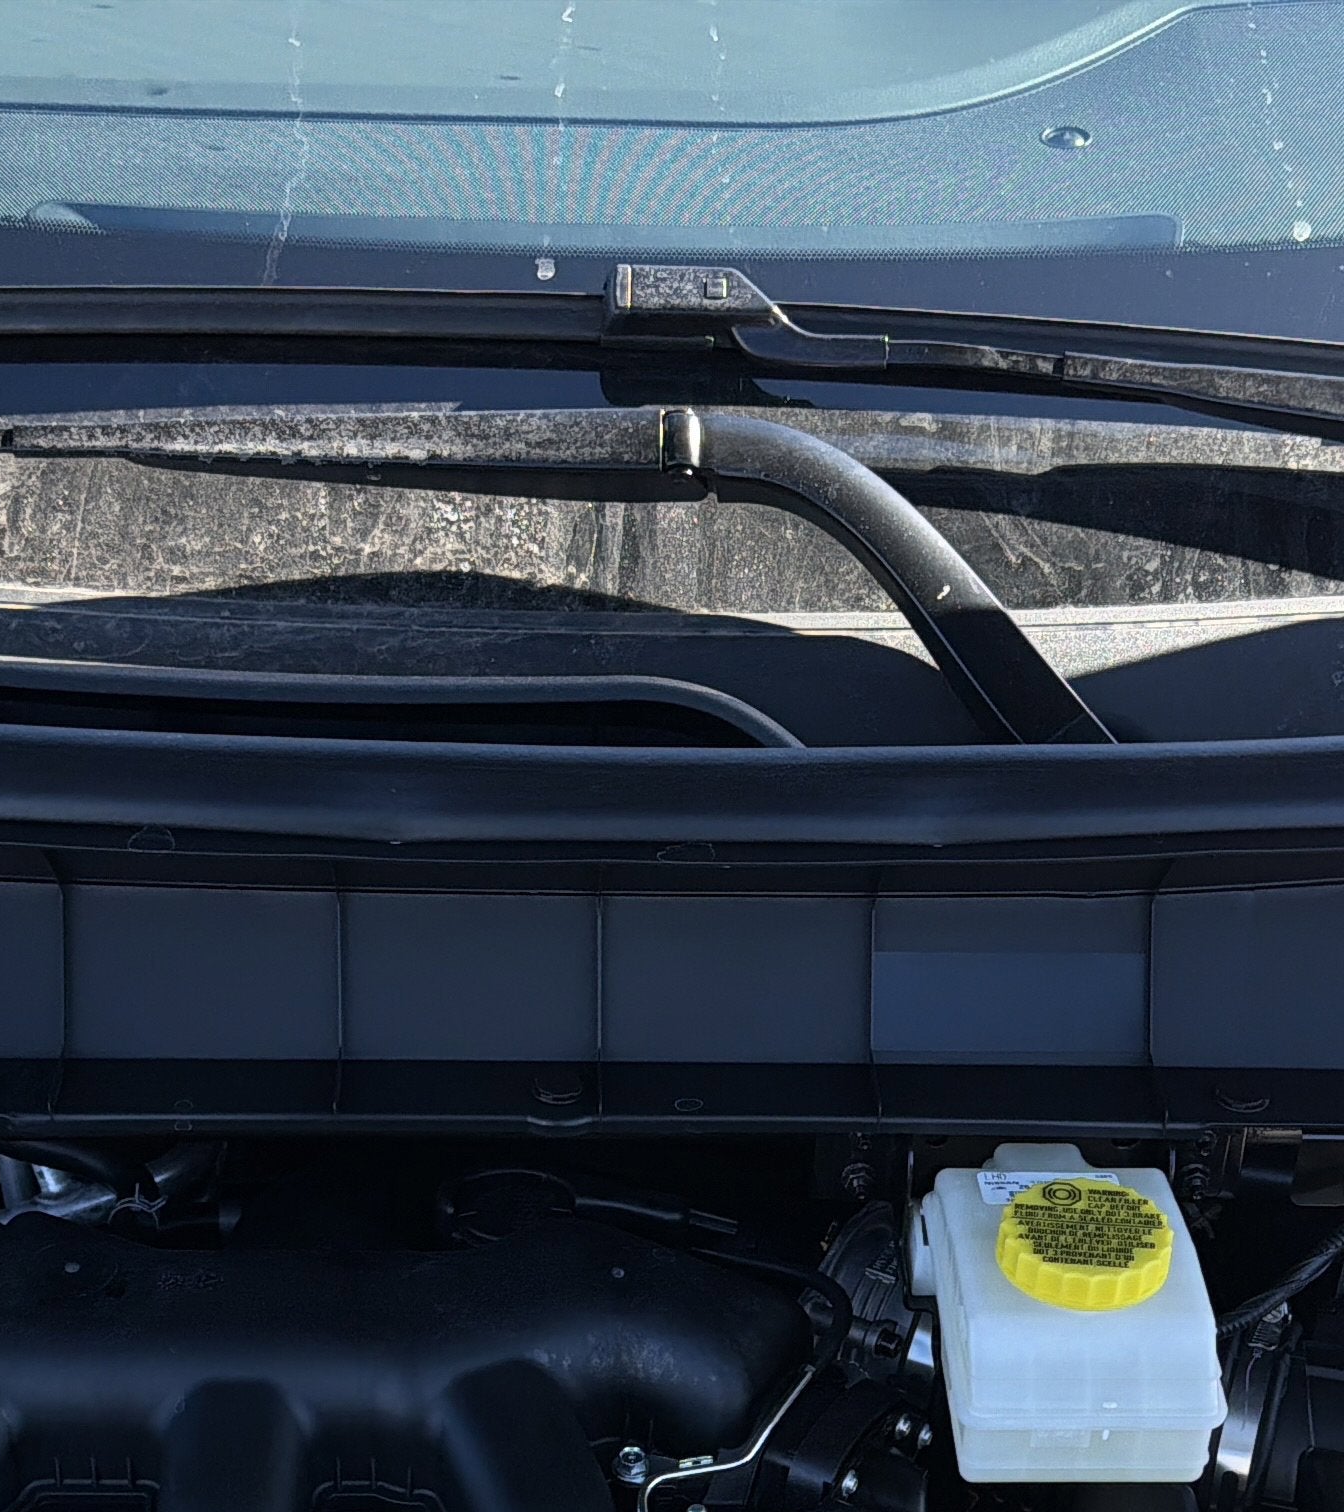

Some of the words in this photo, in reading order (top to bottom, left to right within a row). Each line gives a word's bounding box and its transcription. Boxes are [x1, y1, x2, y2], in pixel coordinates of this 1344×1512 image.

[1087, 1195, 1117, 1203] CLEAN
[1118, 1197, 1149, 1206] FILLER
[1080, 1208, 1102, 1216] ONLY
[1018, 1233, 1048, 1241] AVANT
